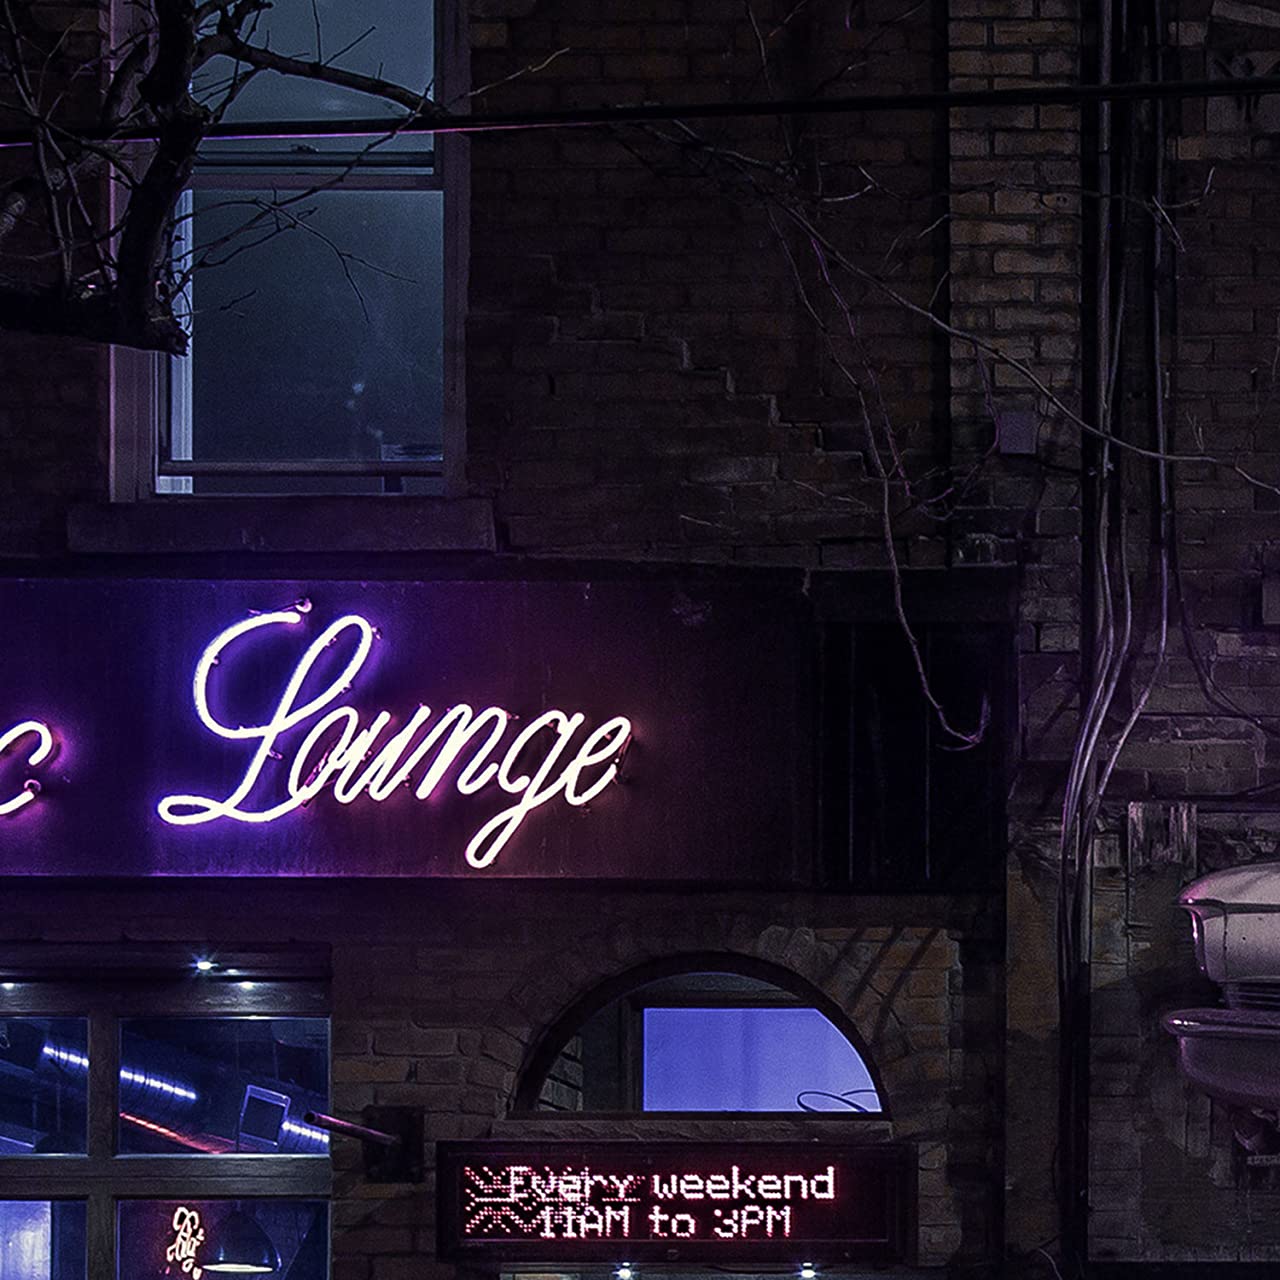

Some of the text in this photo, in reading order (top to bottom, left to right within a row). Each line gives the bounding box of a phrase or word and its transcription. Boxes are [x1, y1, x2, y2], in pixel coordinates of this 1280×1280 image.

[158, 611, 632, 869] Lounge
[508, 1165, 837, 1201] Every weekend
[648, 1205, 697, 1238] to
[713, 1205, 793, 1239] 3PM
